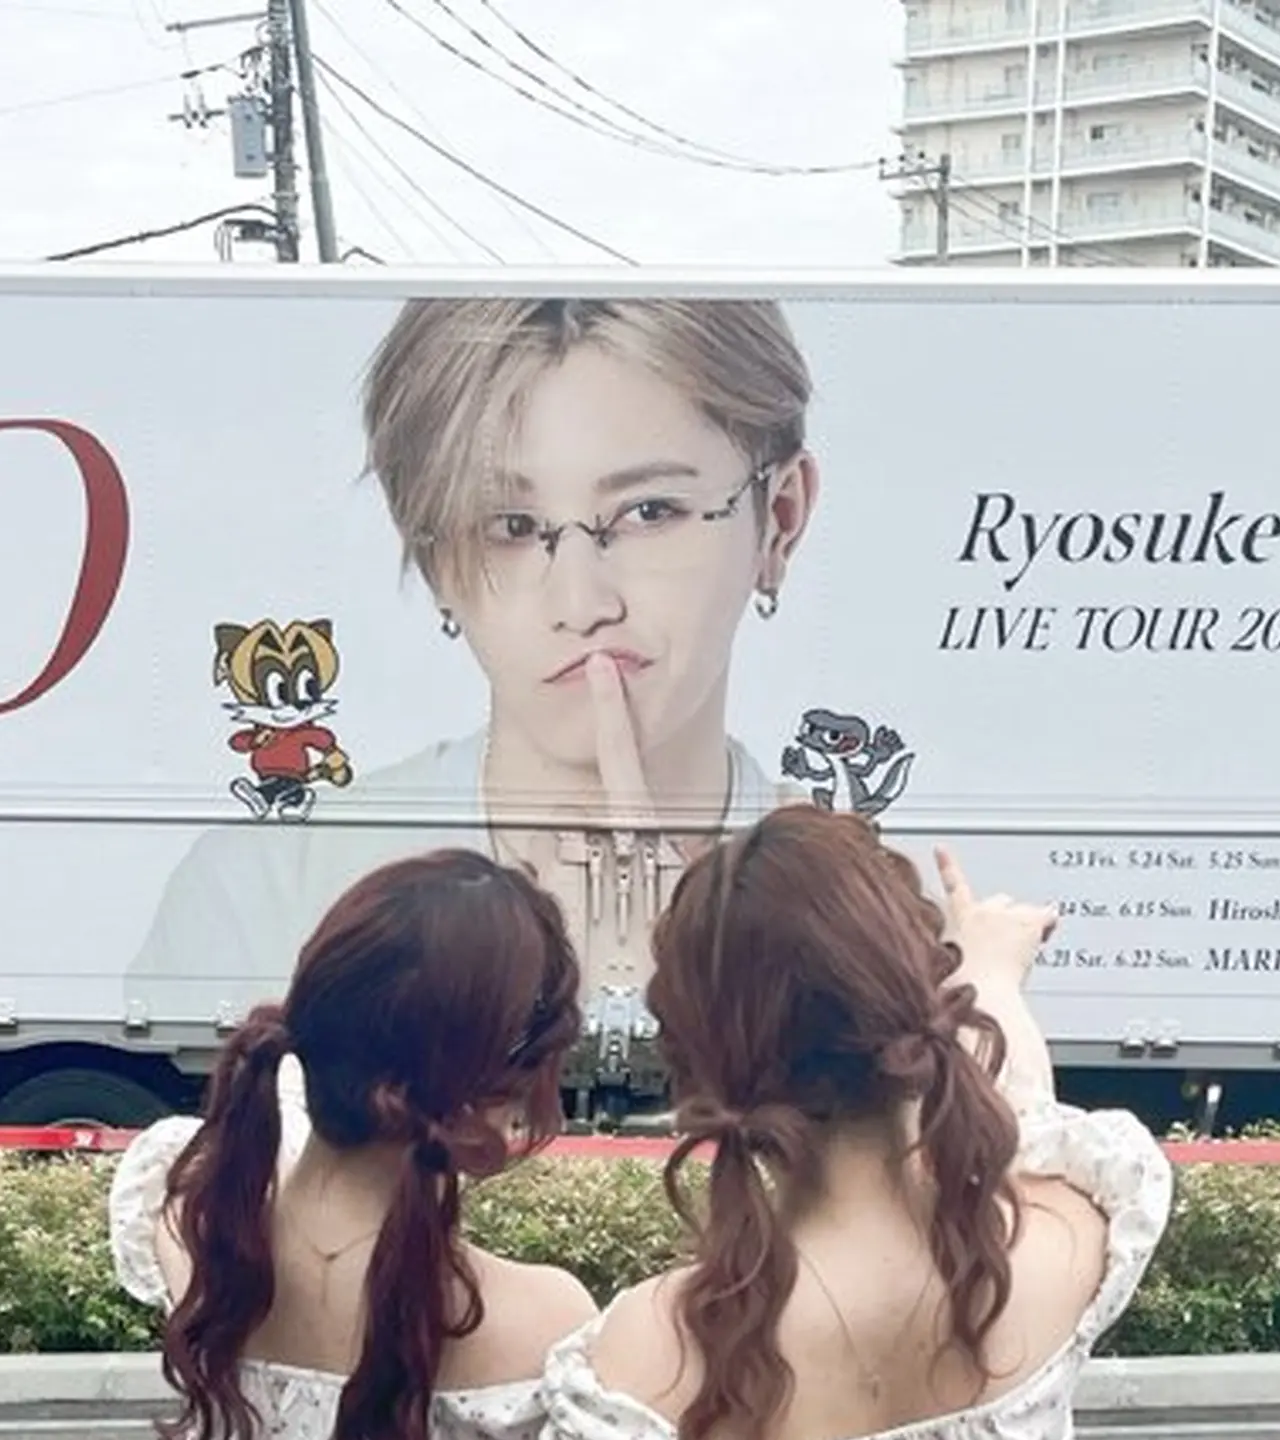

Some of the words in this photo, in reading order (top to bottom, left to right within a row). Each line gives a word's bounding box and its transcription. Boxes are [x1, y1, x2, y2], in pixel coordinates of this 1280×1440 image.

[937, 605, 1058, 652] LIVE
[1074, 605, 1221, 653] TOUR
[1048, 850, 1084, 869] 5.23
[1127, 850, 1163, 869] 5.24
[1208, 850, 1244, 870] 5.25
[1057, 900, 1077, 918] 14
[1118, 899, 1156, 918] 6.15
[1113, 948, 1153, 968] 6.22
